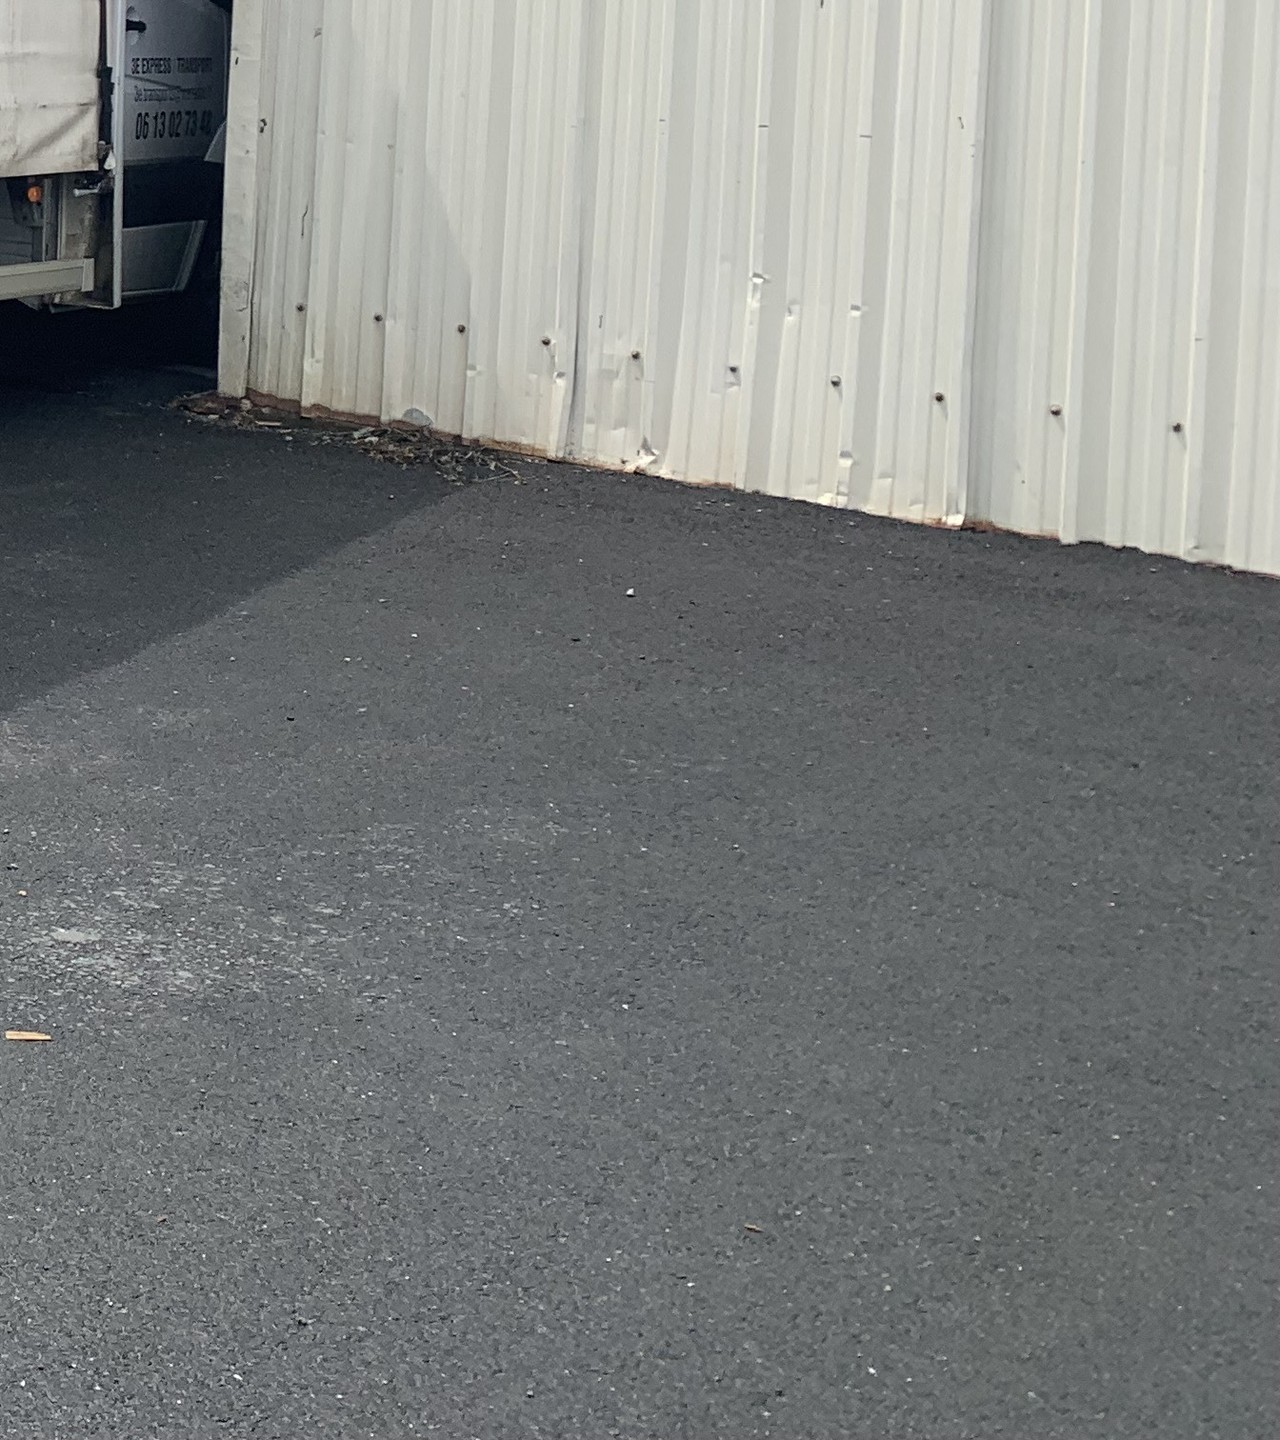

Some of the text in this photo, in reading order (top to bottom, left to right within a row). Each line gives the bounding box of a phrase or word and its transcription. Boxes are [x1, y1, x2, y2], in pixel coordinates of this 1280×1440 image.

[141, 57, 172, 74] EXPRESS
[135, 112, 149, 140] 06
[153, 111, 166, 138] 13
[169, 110, 182, 138] 02
